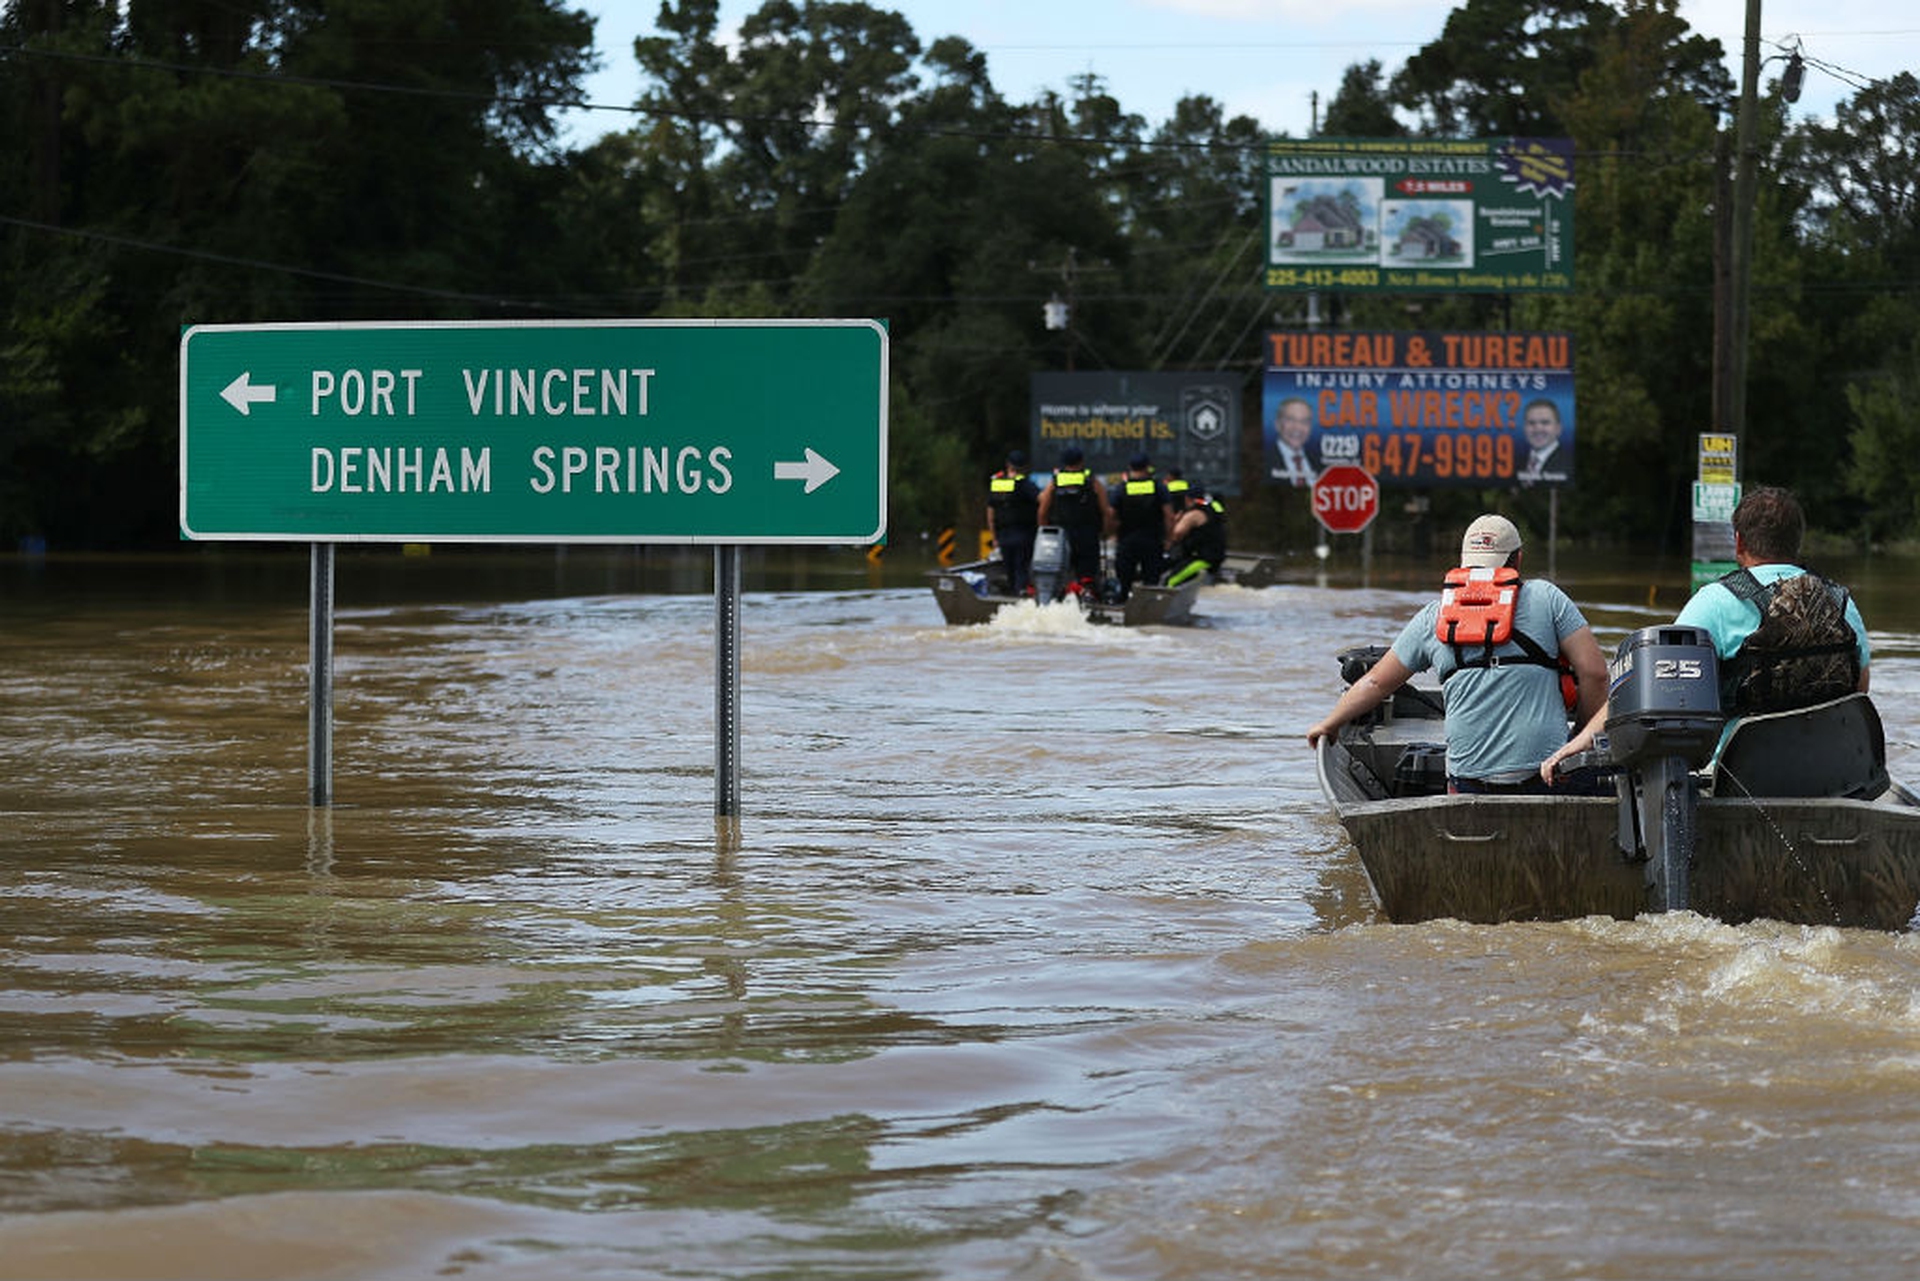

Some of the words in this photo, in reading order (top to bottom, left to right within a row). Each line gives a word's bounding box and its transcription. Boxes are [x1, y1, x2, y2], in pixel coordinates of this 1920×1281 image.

[1268, 158, 1405, 173] SANDALWOOD
[1409, 158, 1490, 173] ESTATES
[1270, 334, 1395, 367] TUREAU
[1406, 336, 1432, 366] &
[1443, 335, 1568, 368] TUREAU
[311, 369, 422, 416] PORT
[463, 368, 656, 416] VINCENT
[1296, 373, 1388, 387] INJURY
[1400, 373, 1547, 389] ATTORNEYS
[1040, 404, 1076, 416] Home
[1078, 404, 1089, 416] is
[1091, 404, 1128, 416] where
[1131, 404, 1160, 418] your
[1318, 390, 1378, 427] CAR
[1389, 390, 1521, 428] WRECK?
[1041, 417, 1145, 439] handheld
[1150, 418, 1176, 439] is.
[1321, 434, 1360, 458] (225)
[1363, 433, 1514, 478] 647-9999
[311, 447, 491, 493] DENHAM
[530, 446, 733, 494] SPRINGS
[1316, 486, 1375, 511] STOP
[1655, 659, 1702, 679] 25
